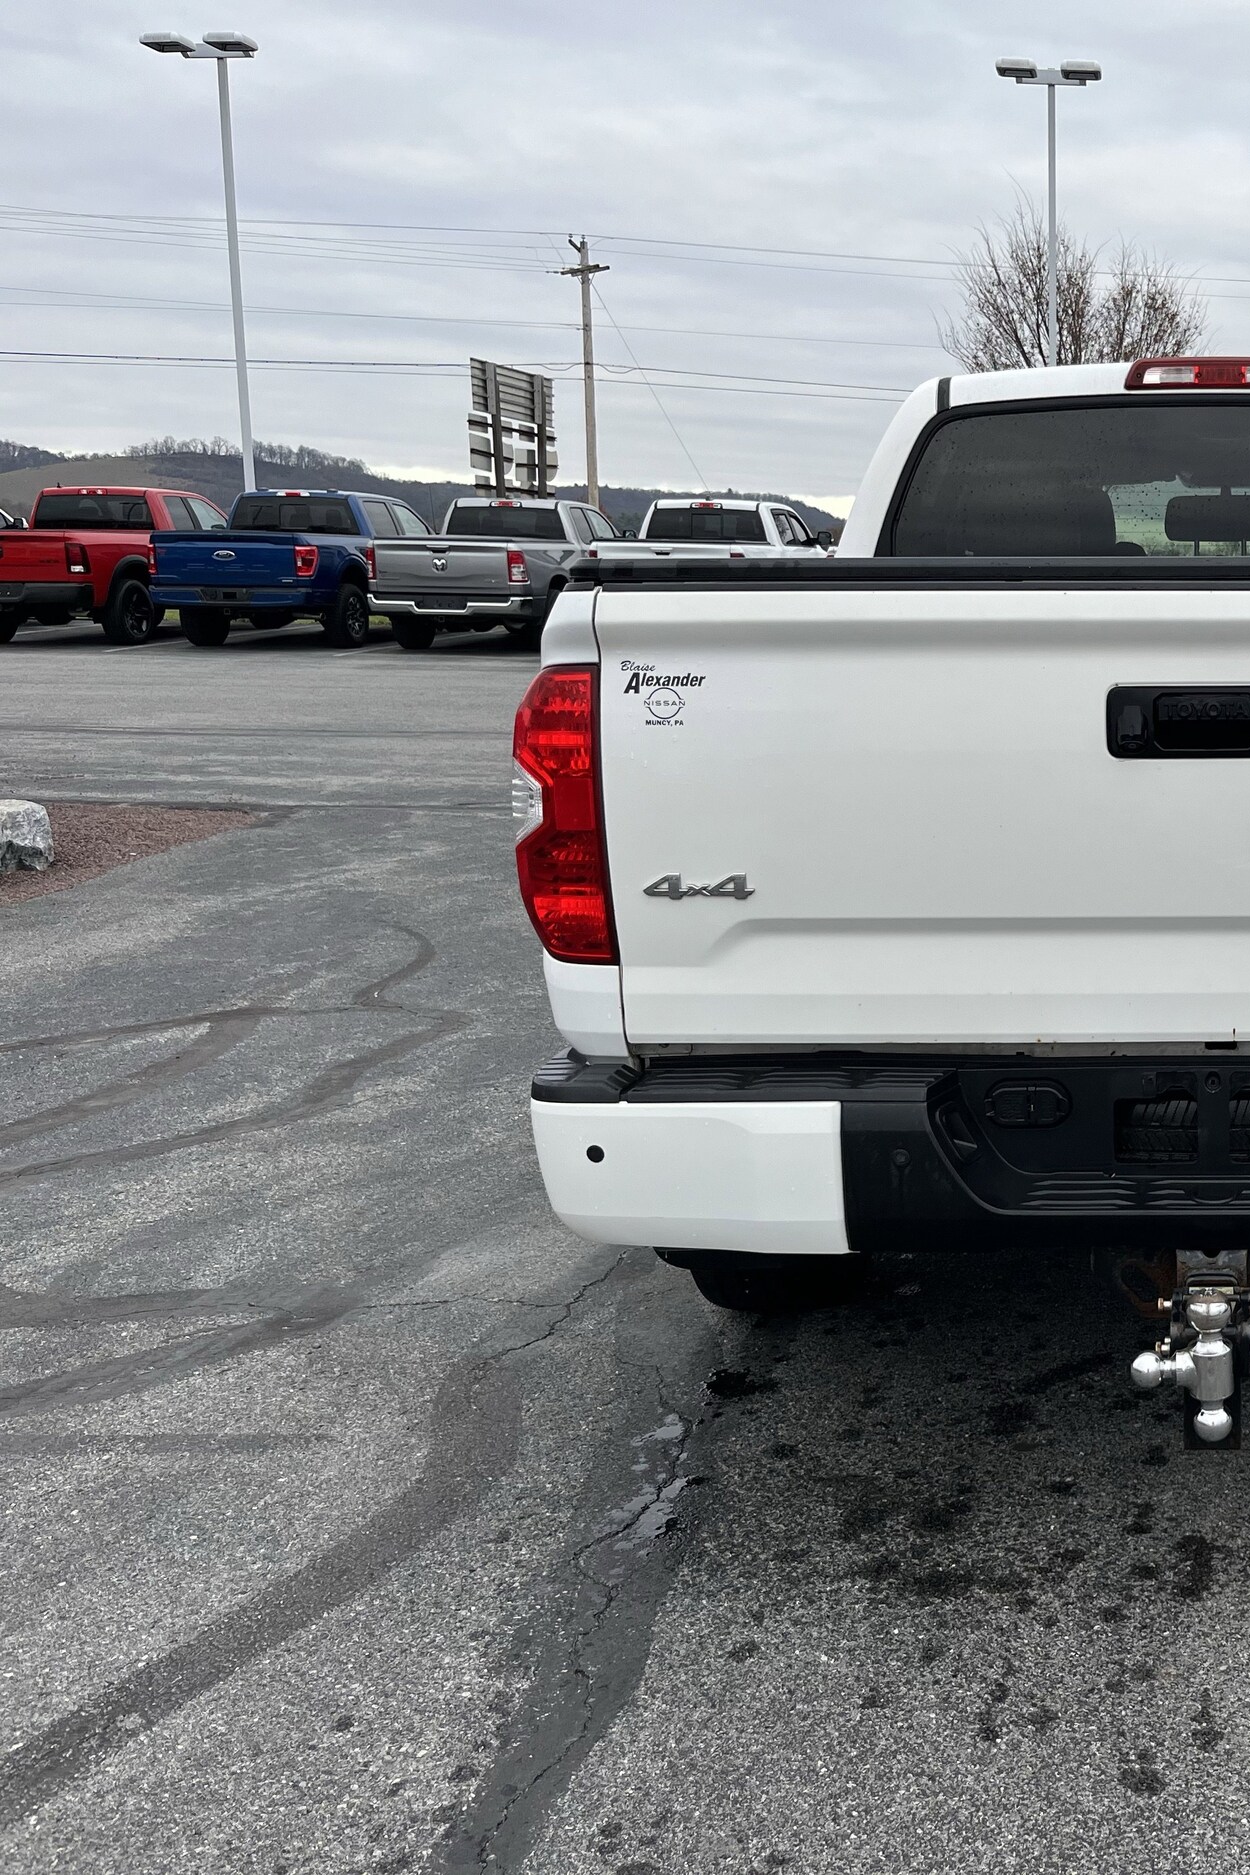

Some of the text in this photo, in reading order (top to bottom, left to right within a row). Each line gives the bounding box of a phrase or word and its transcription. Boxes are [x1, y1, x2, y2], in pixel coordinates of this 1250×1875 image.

[620, 660, 656, 671] Blaise
[623, 672, 706, 694] Alexander
[1163, 702, 1250, 719] TOYOTA
[643, 872, 755, 900] 4x4
